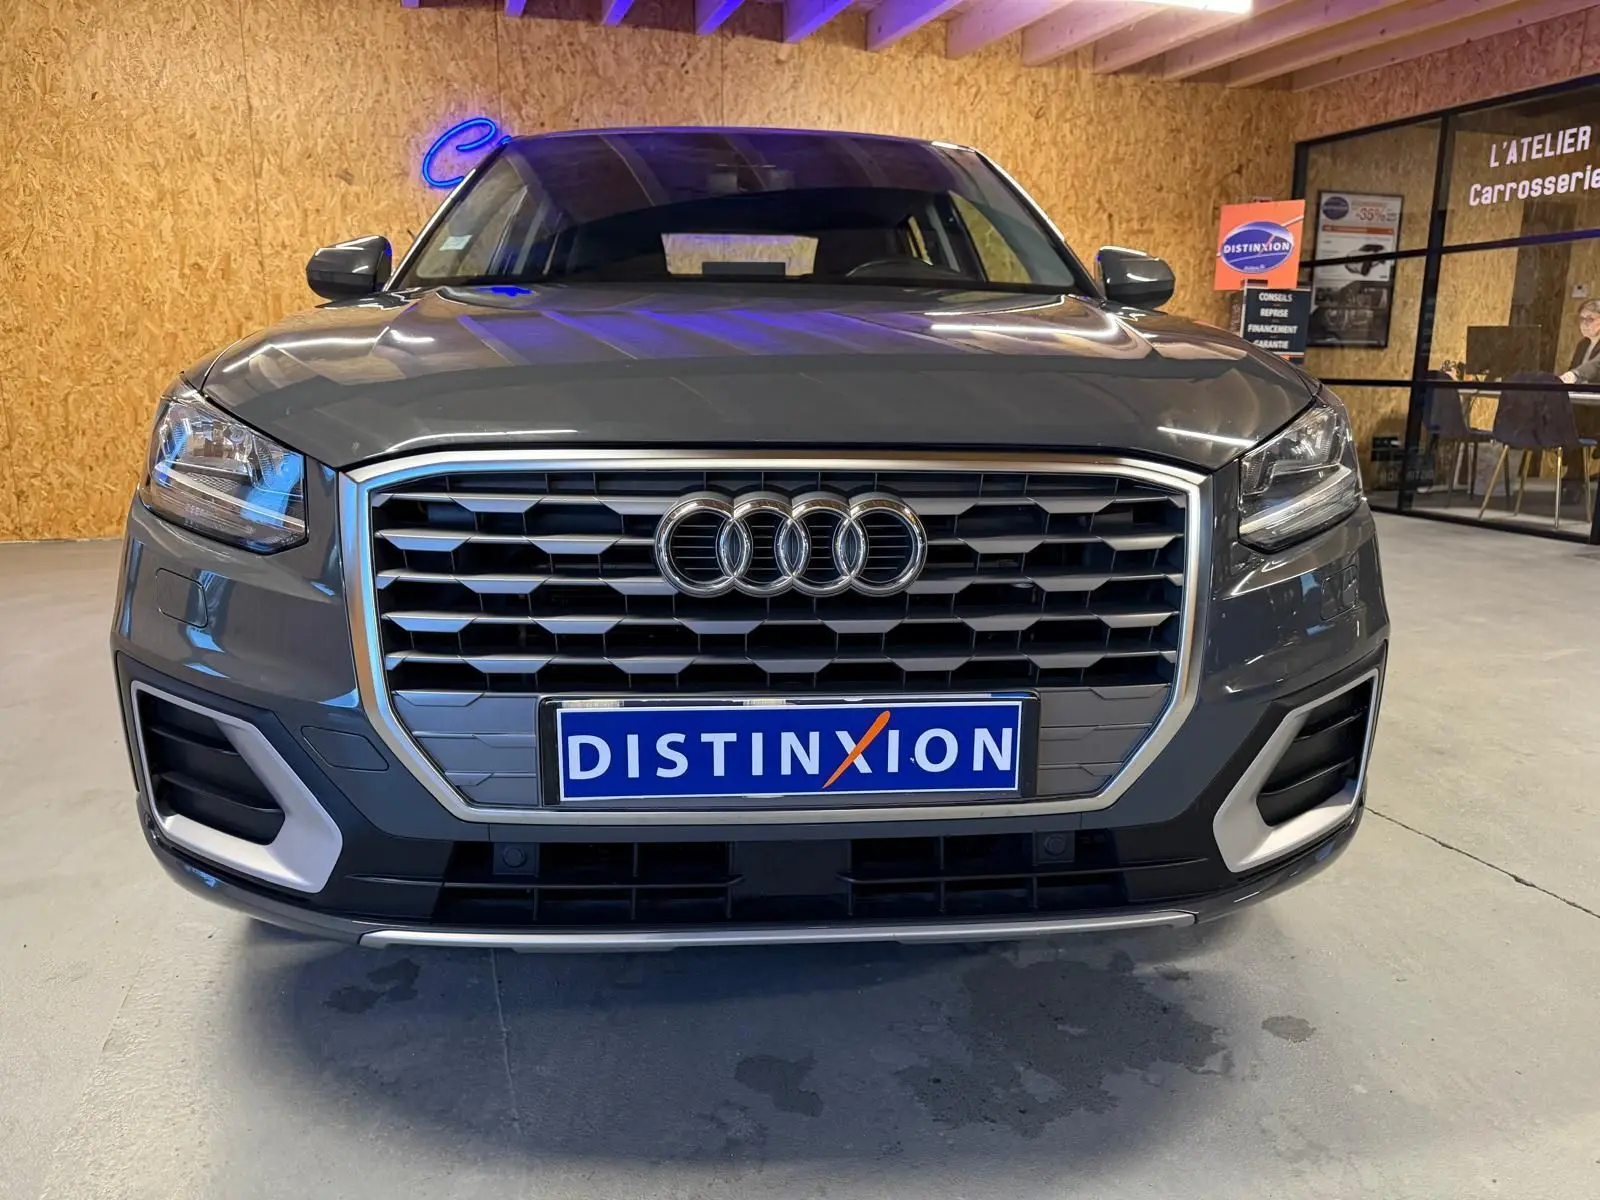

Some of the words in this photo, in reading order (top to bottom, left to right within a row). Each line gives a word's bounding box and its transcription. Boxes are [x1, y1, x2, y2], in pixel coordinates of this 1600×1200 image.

[1489, 125, 1592, 168] L'ATELIER
[1469, 165, 1600, 206] Carrosserie
[1223, 241, 1290, 254] DISTINXION
[1258, 292, 1293, 302] CONSEILS
[1260, 308, 1289, 318] REPRISE
[1247, 324, 1298, 334] FINANCEMENT
[567, 716, 1012, 786] DISTINXION
